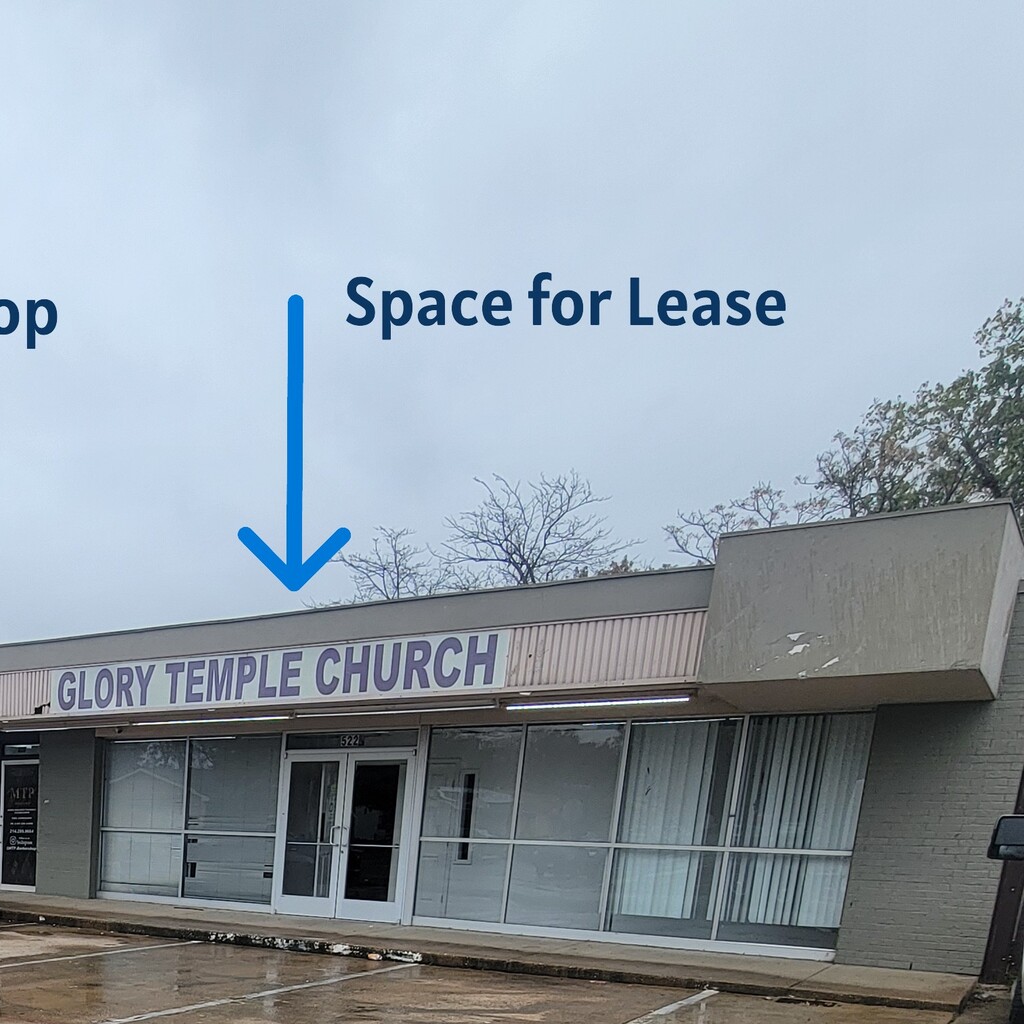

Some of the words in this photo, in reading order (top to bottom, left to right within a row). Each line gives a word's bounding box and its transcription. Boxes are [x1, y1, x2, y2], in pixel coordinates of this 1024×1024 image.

[57, 665, 155, 711] GLORY
[165, 650, 302, 705] TEMPLE
[315, 634, 498, 696] CHURCH
